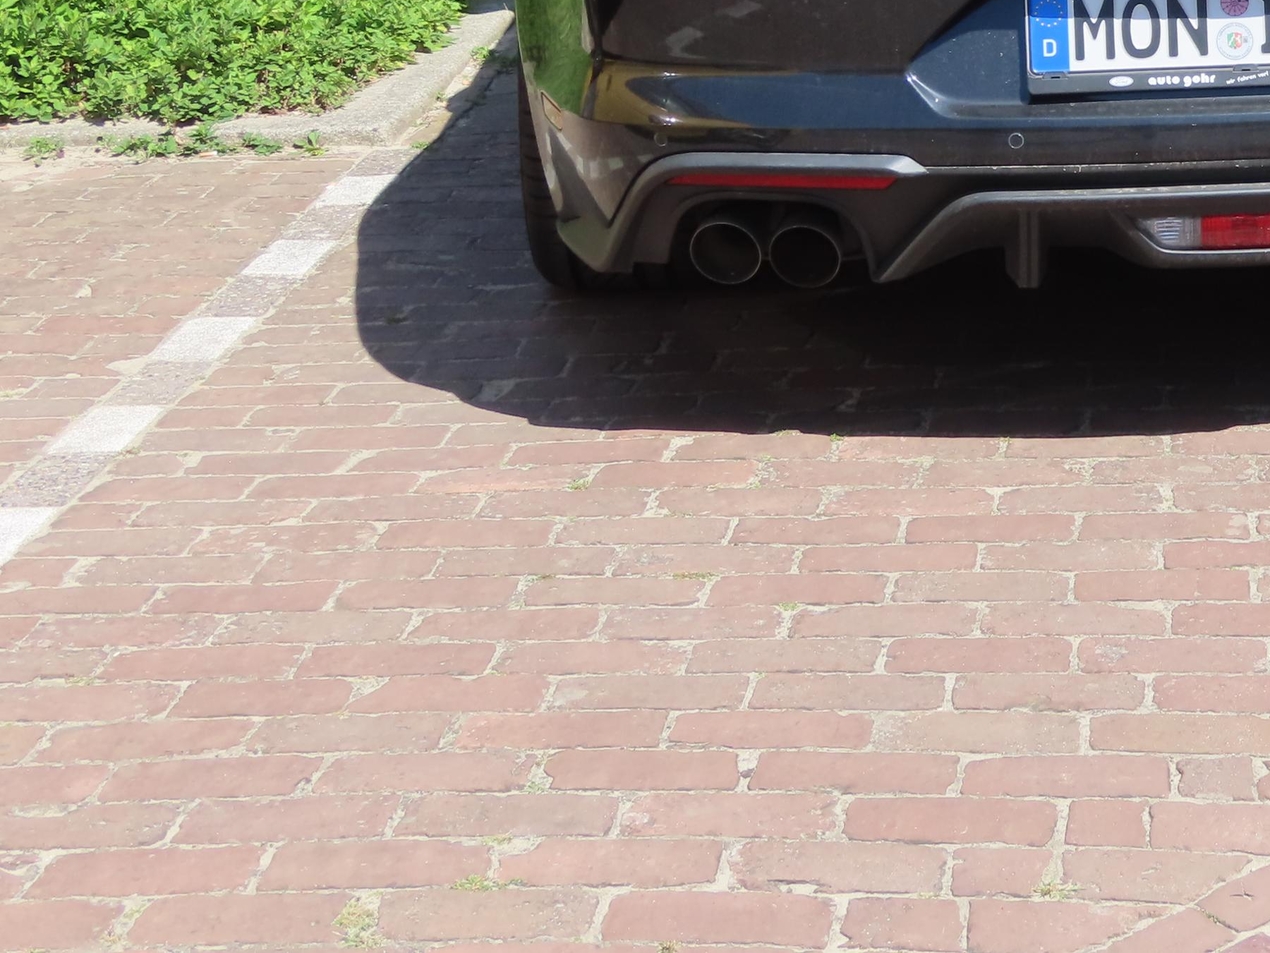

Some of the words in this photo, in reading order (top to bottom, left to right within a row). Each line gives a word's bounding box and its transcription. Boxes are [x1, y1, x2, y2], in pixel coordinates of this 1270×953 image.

[1042, 39, 1057, 58] D
[1147, 75, 1180, 86] auto
[1183, 72, 1216, 87] gohr
